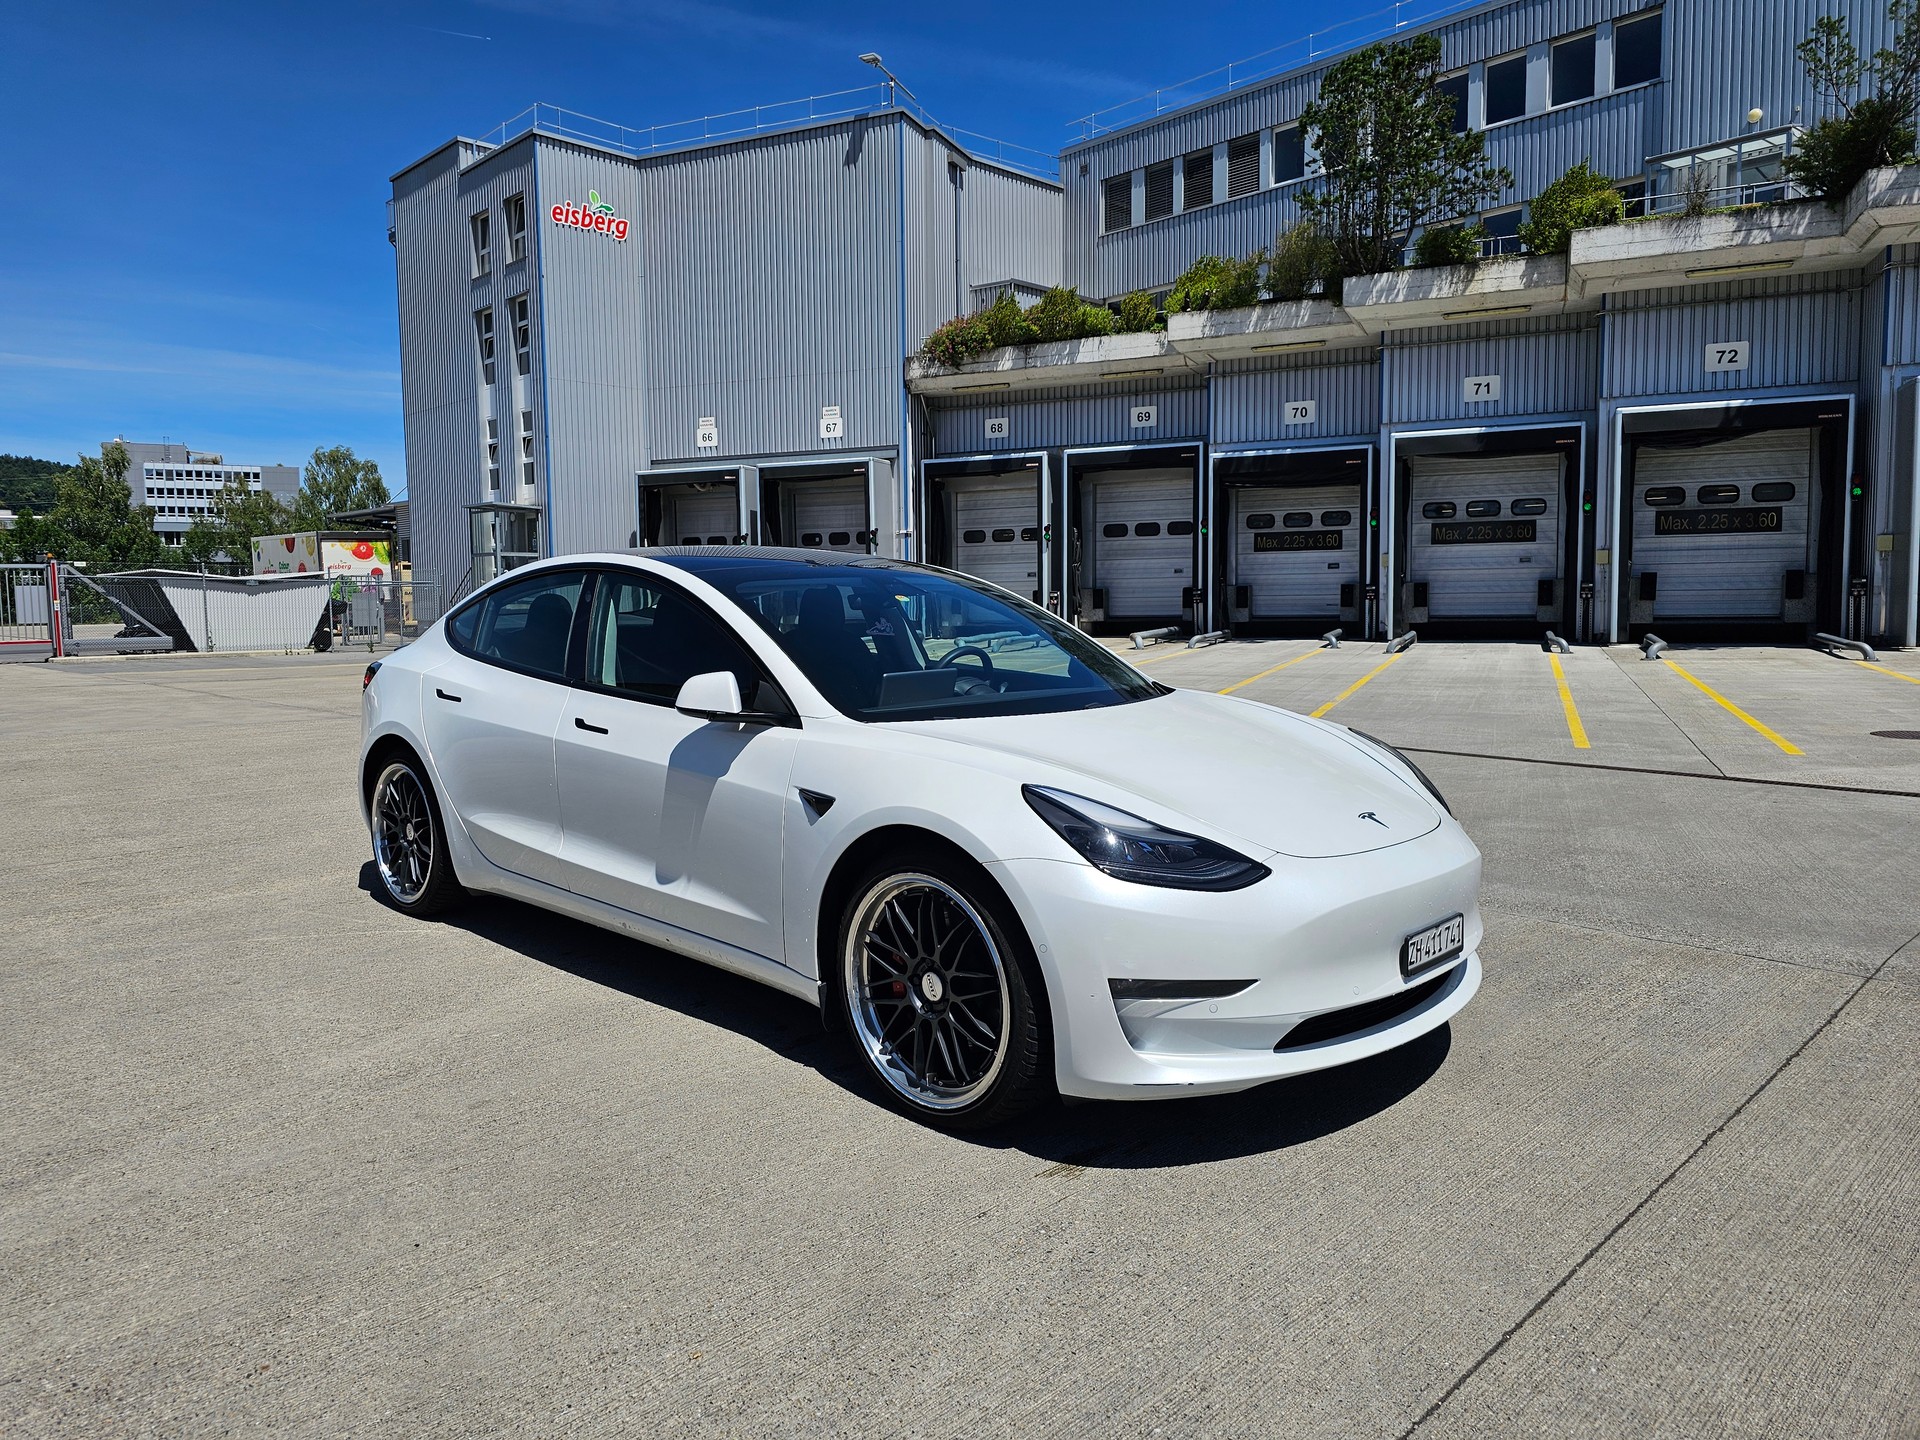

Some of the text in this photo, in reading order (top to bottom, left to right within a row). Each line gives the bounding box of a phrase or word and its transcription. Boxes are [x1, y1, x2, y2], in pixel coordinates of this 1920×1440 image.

[551, 200, 629, 240] eisberg
[1716, 349, 1738, 364] 72
[1473, 382, 1490, 395] 71
[1137, 411, 1151, 422] 69
[1292, 406, 1307, 418] 70
[825, 423, 837, 433] 67
[990, 423, 1003, 433] 68
[702, 433, 713, 442] 66
[1660, 512, 1777, 530] Max. 2.25 x 3.60
[1435, 525, 1532, 540] Max. 2.25 x 3.60
[1257, 534, 1339, 549] Max. 2.25 x 3.60
[329, 563, 352, 571] eisberg
